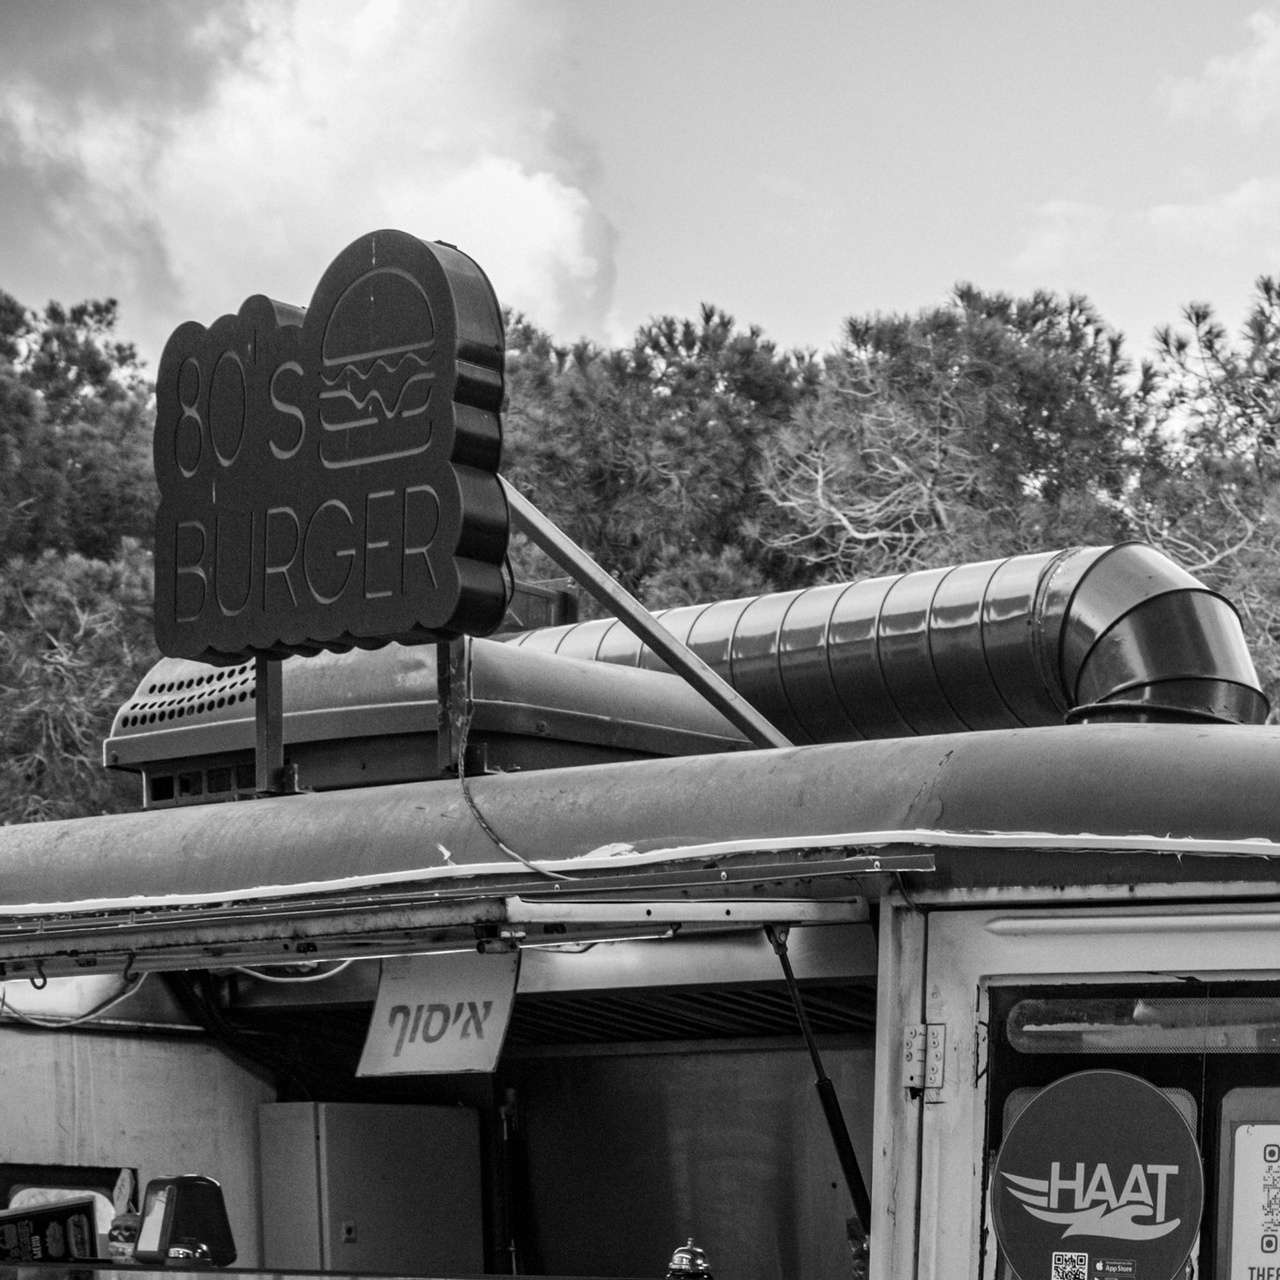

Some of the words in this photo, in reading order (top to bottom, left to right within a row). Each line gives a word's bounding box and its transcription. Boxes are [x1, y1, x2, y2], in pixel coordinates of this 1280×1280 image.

[174, 328, 306, 479] 80'S
[174, 484, 441, 623] BURGER
[388, 1000, 493, 1058] איסוף
[1048, 1161, 1180, 1224] HAAT
[1105, 1265, 1117, 1273] App
[1117, 1265, 1133, 1273] Store
